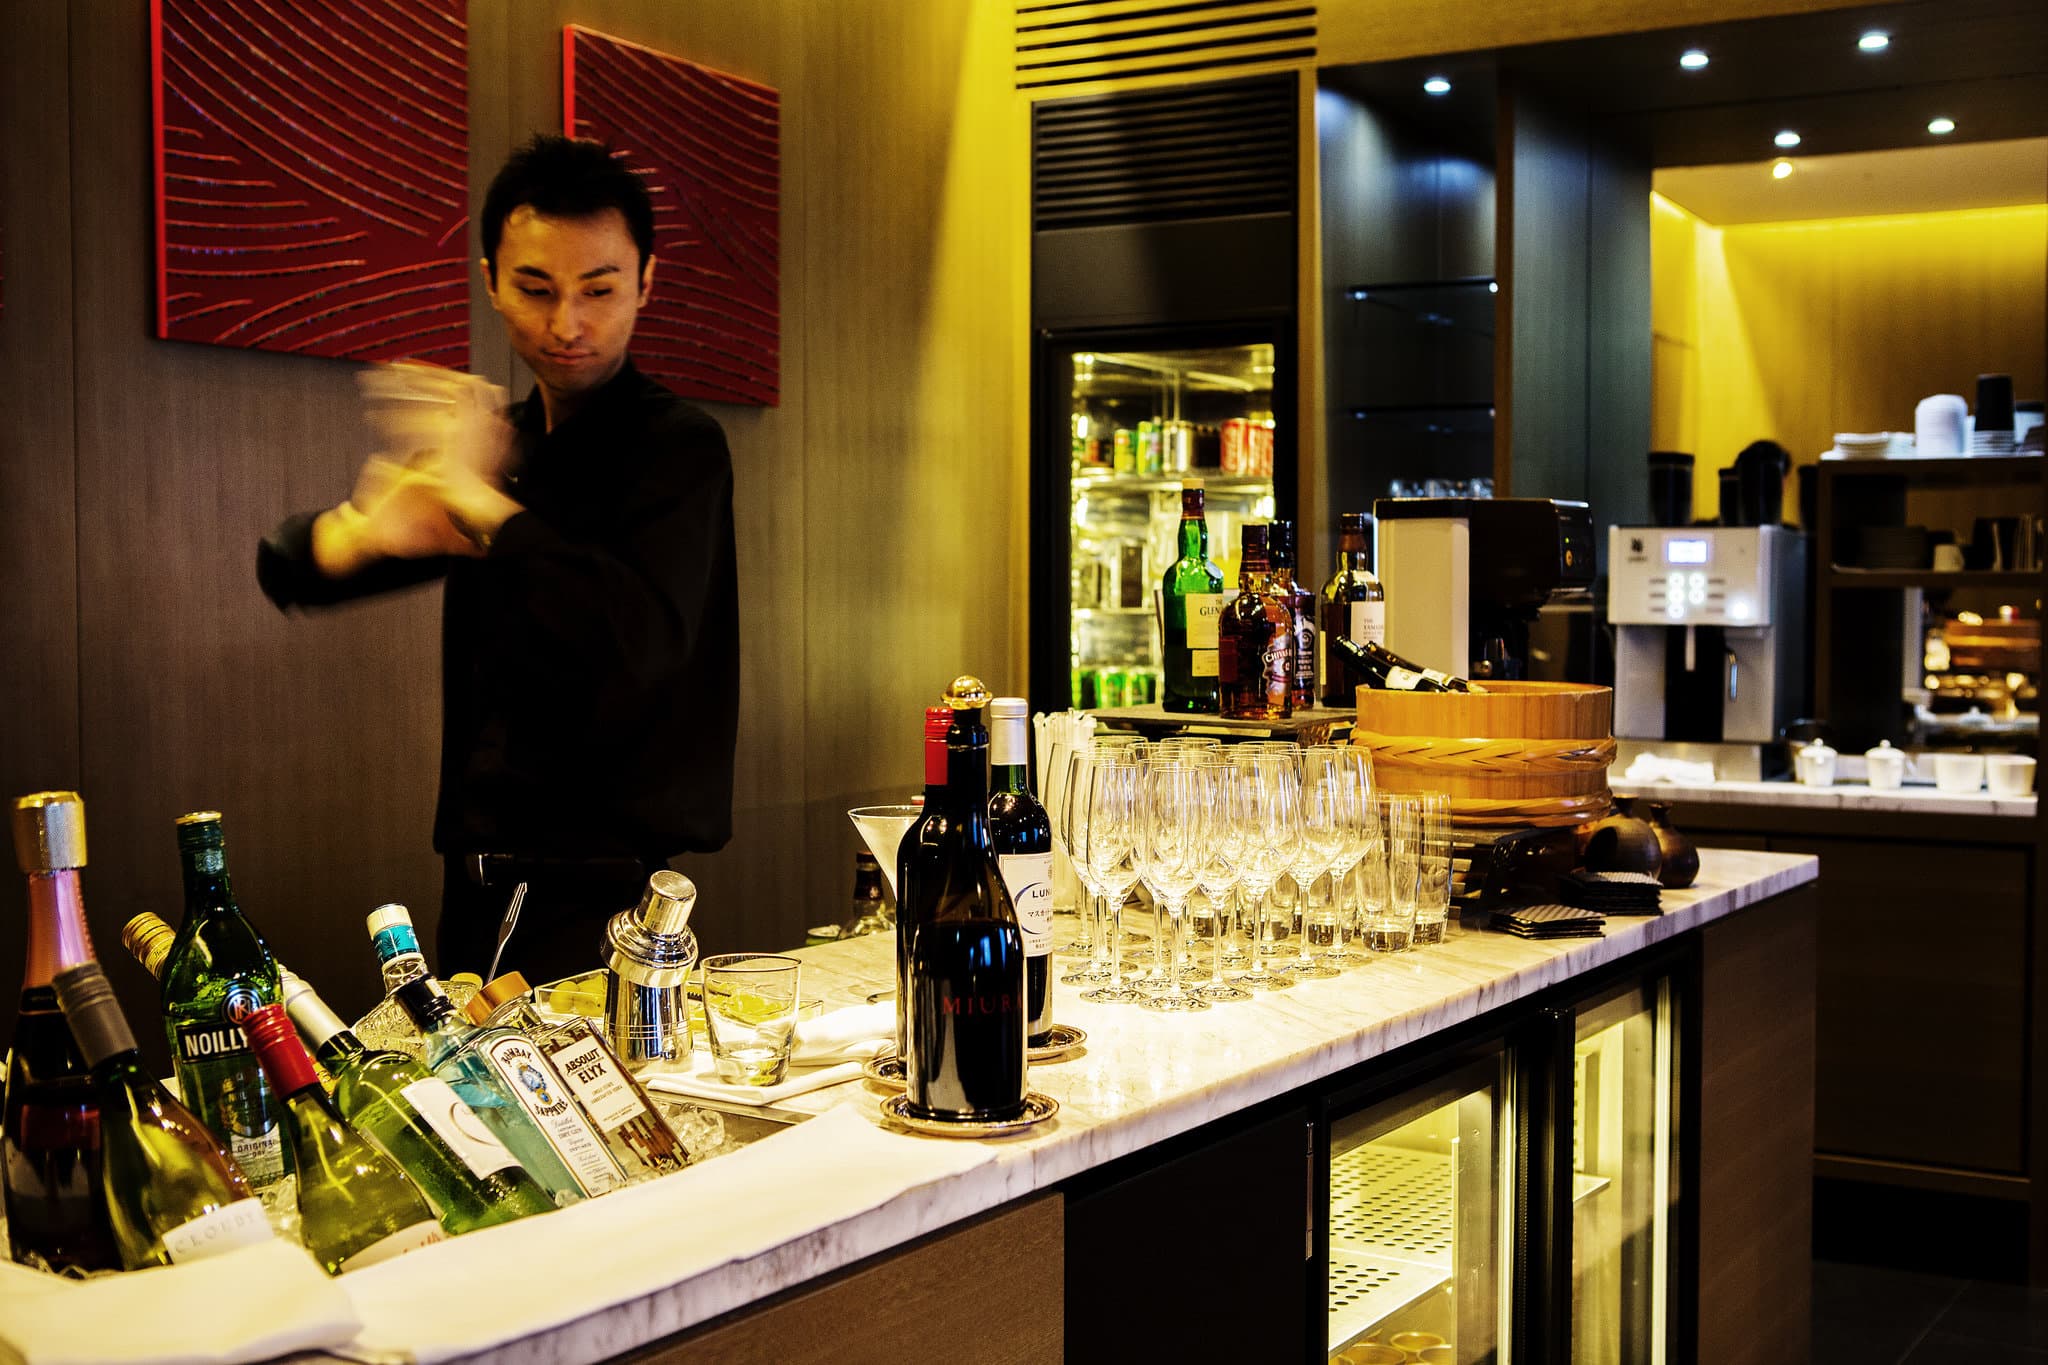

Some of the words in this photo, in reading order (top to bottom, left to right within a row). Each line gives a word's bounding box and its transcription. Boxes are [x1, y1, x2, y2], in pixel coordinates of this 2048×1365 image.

[185, 1026, 249, 1058] NOILLY
[500, 1047, 532, 1065] BOMBAY
[565, 1047, 601, 1073] ABSOLUT
[578, 1062, 607, 1085] ELYX
[534, 1096, 569, 1117] SAPPHIRE
